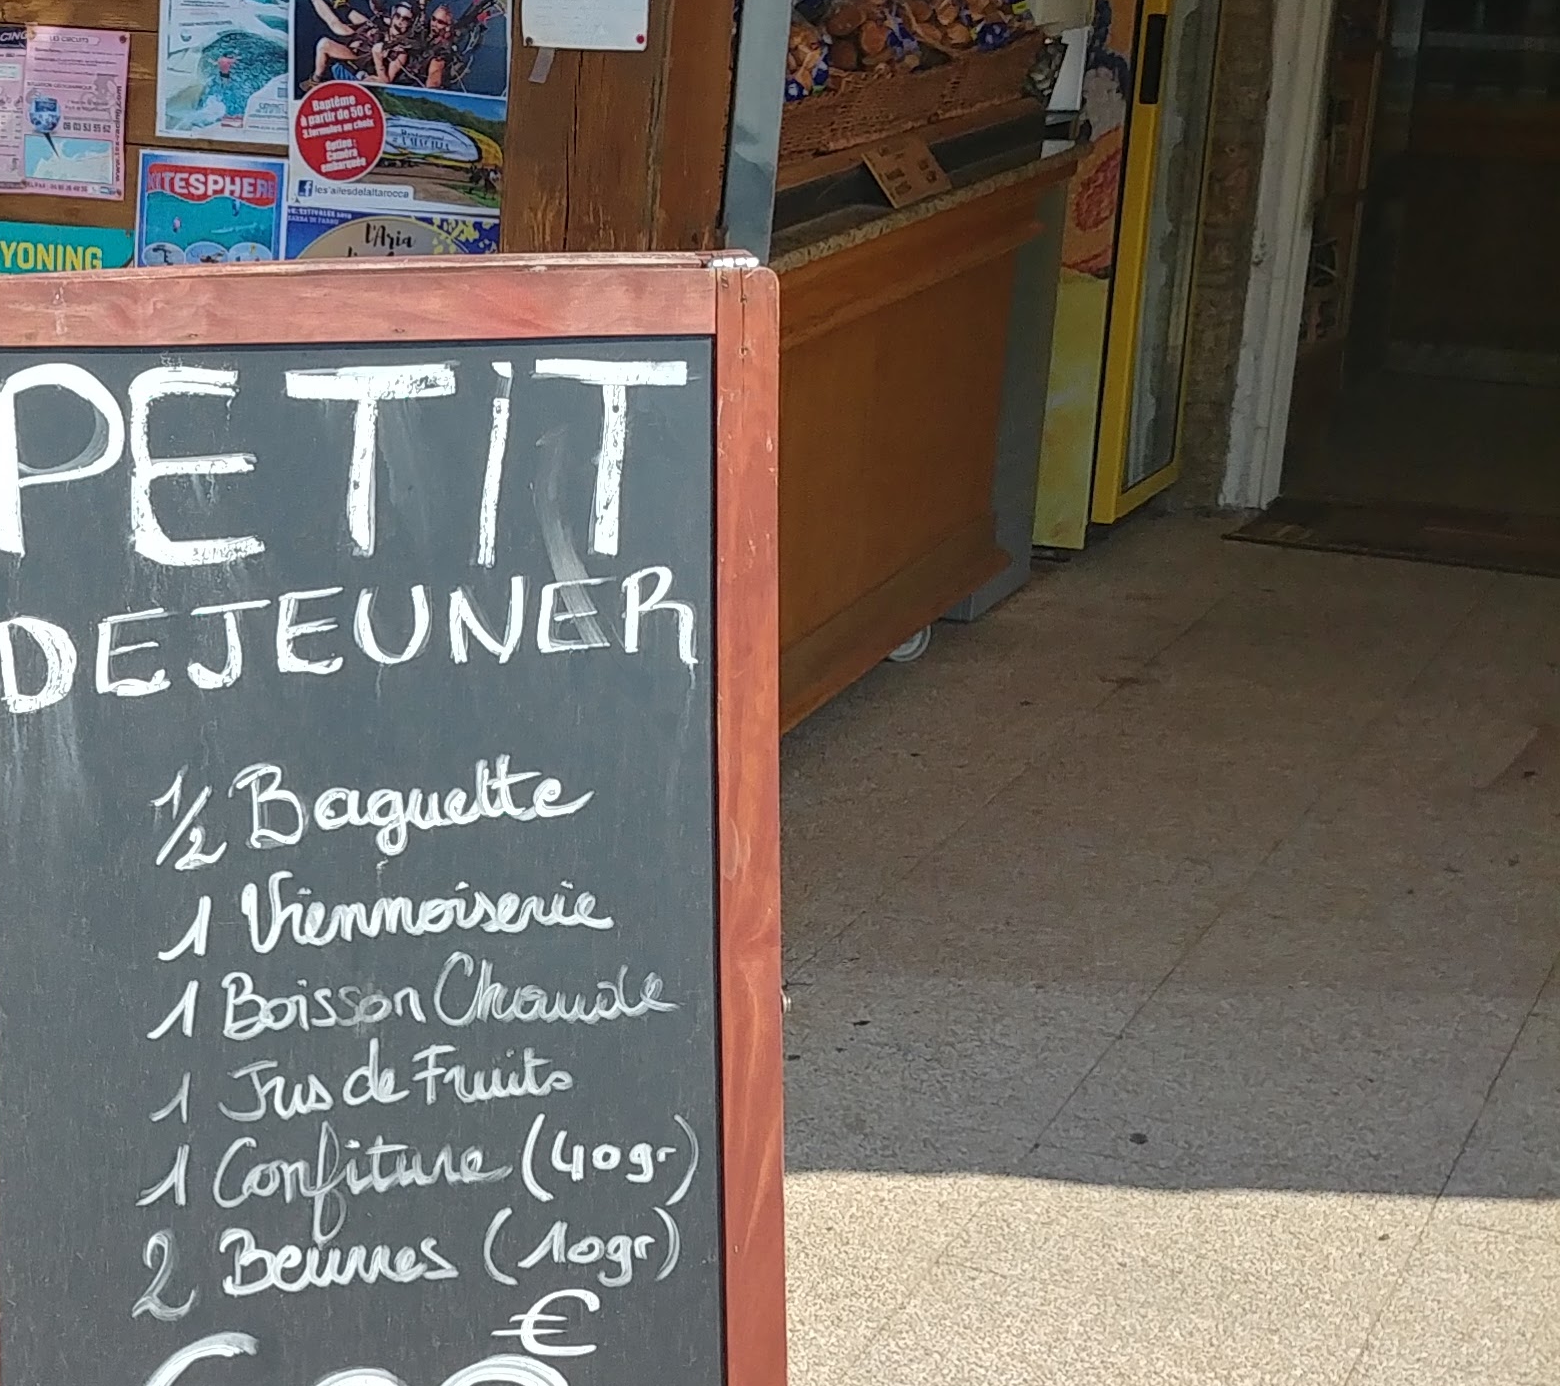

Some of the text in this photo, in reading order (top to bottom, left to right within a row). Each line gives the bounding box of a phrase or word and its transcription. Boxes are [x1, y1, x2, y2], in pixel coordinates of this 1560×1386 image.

[312, 94, 356, 112] Baptême
[351, 106, 364, 118] 50
[147, 171, 276, 199] KITESPHERE
[228, 754, 595, 857] Baguette
[156, 871, 614, 962] 1 Viennoiserie
[148, 951, 683, 1040] 1 Boisson Chaude
[151, 1038, 574, 1124] 1 Jus de Fruits
[135, 1113, 700, 1244] 1 Confiture (40gr)
[132, 1206, 681, 1322] 2 Beurres (10gr)
